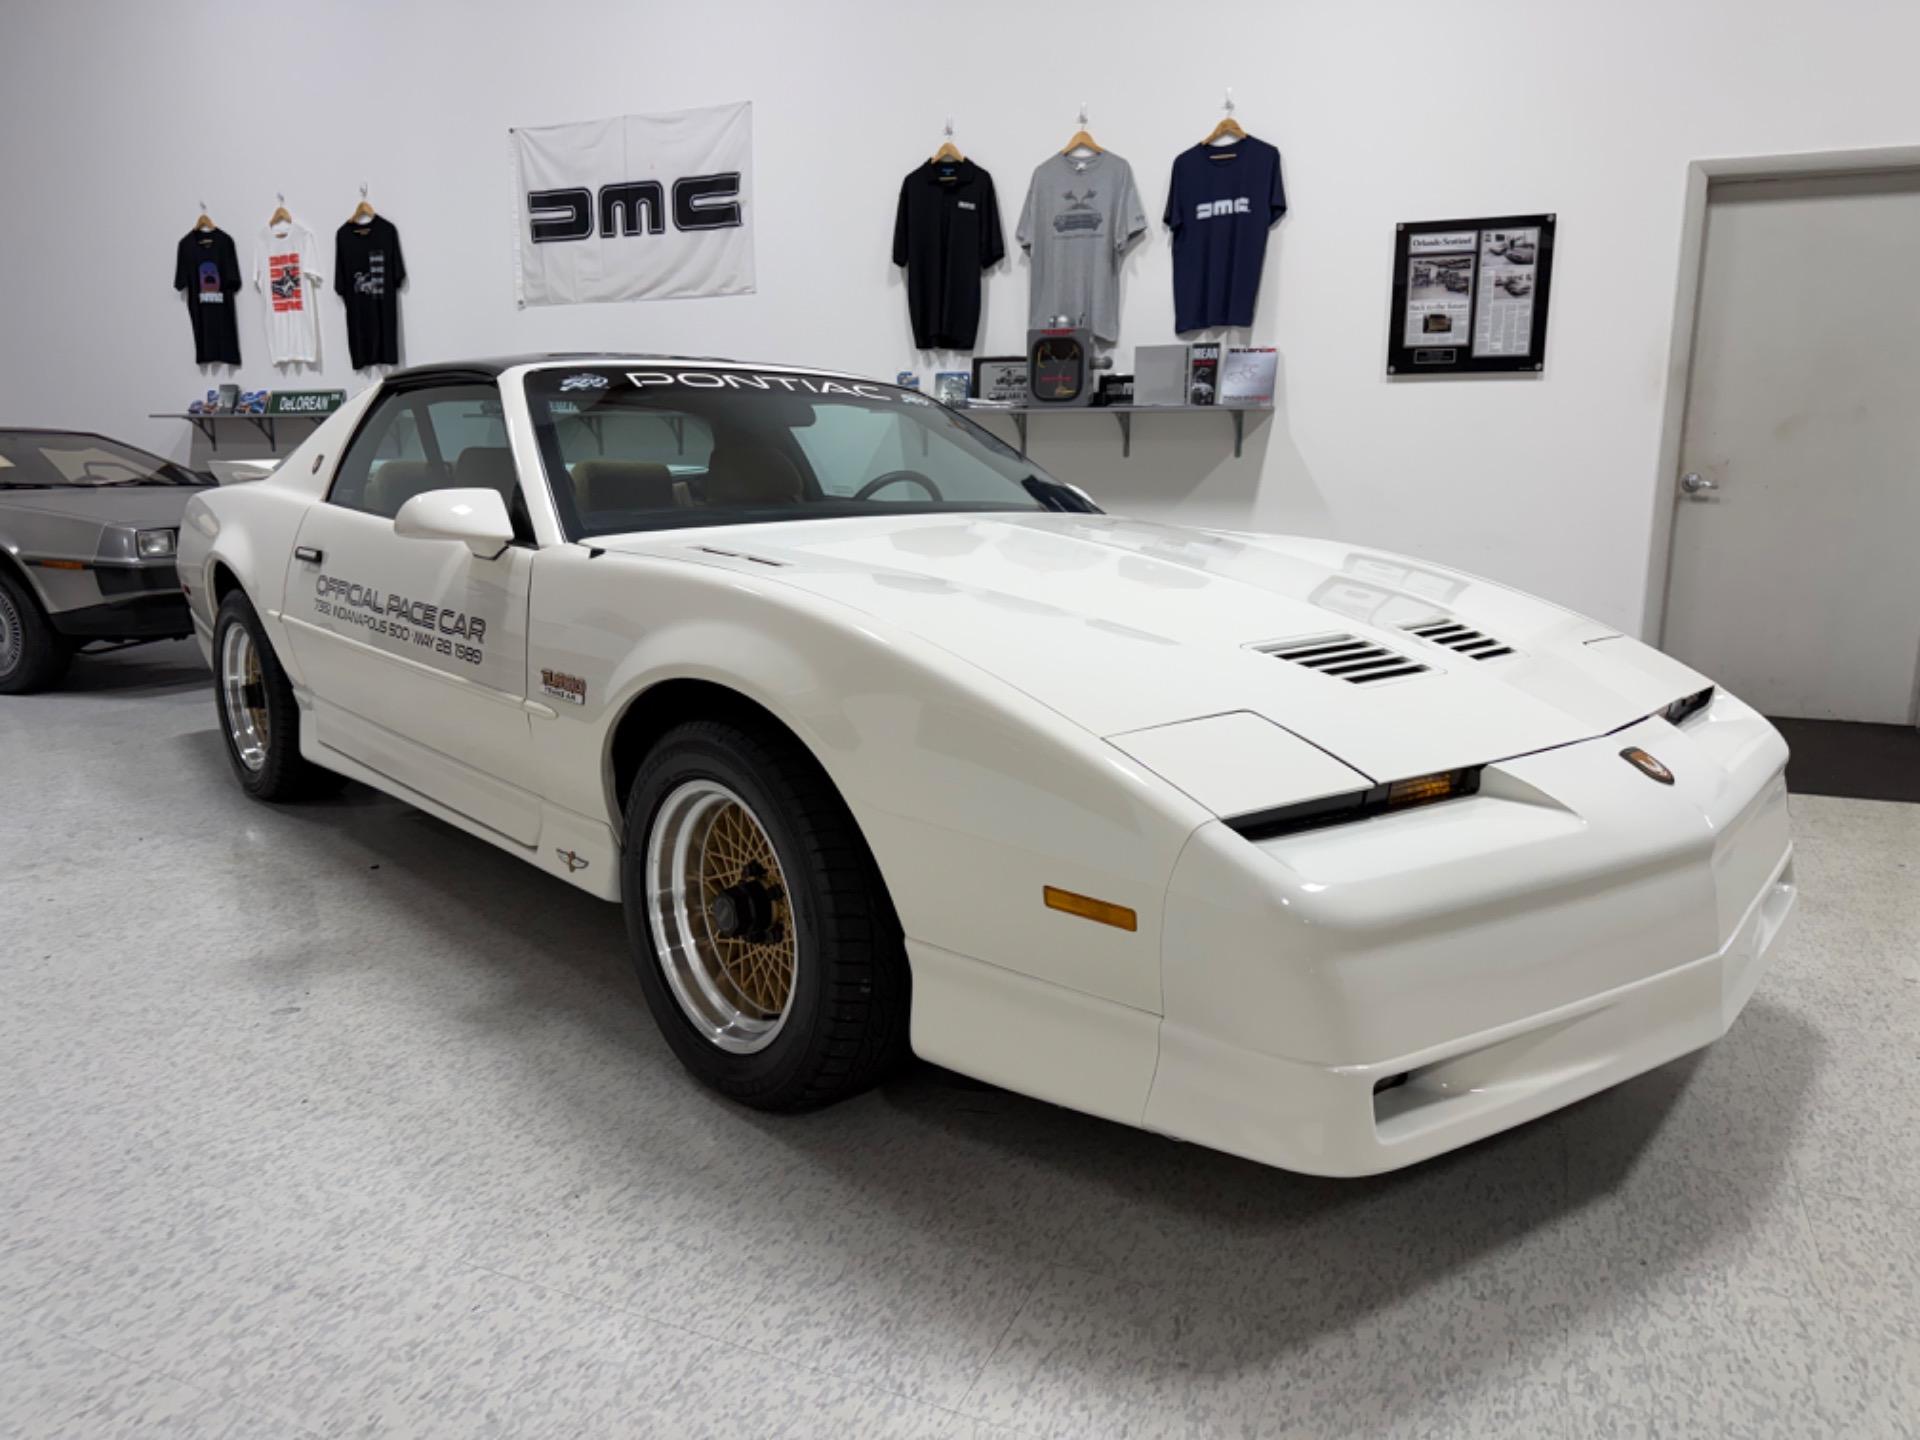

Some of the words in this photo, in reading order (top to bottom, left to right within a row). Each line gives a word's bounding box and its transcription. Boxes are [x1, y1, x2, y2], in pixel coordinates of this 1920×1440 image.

[625, 372, 892, 401] PONTIAC
[315, 574, 385, 615] OFFICIAL
[386, 593, 438, 630] PACE
[438, 608, 486, 644] CAR
[332, 603, 387, 634] INDIANAPOLIS
[388, 621, 410, 641] 500
[413, 631, 435, 649] MAY
[454, 642, 483, 665] 1989
